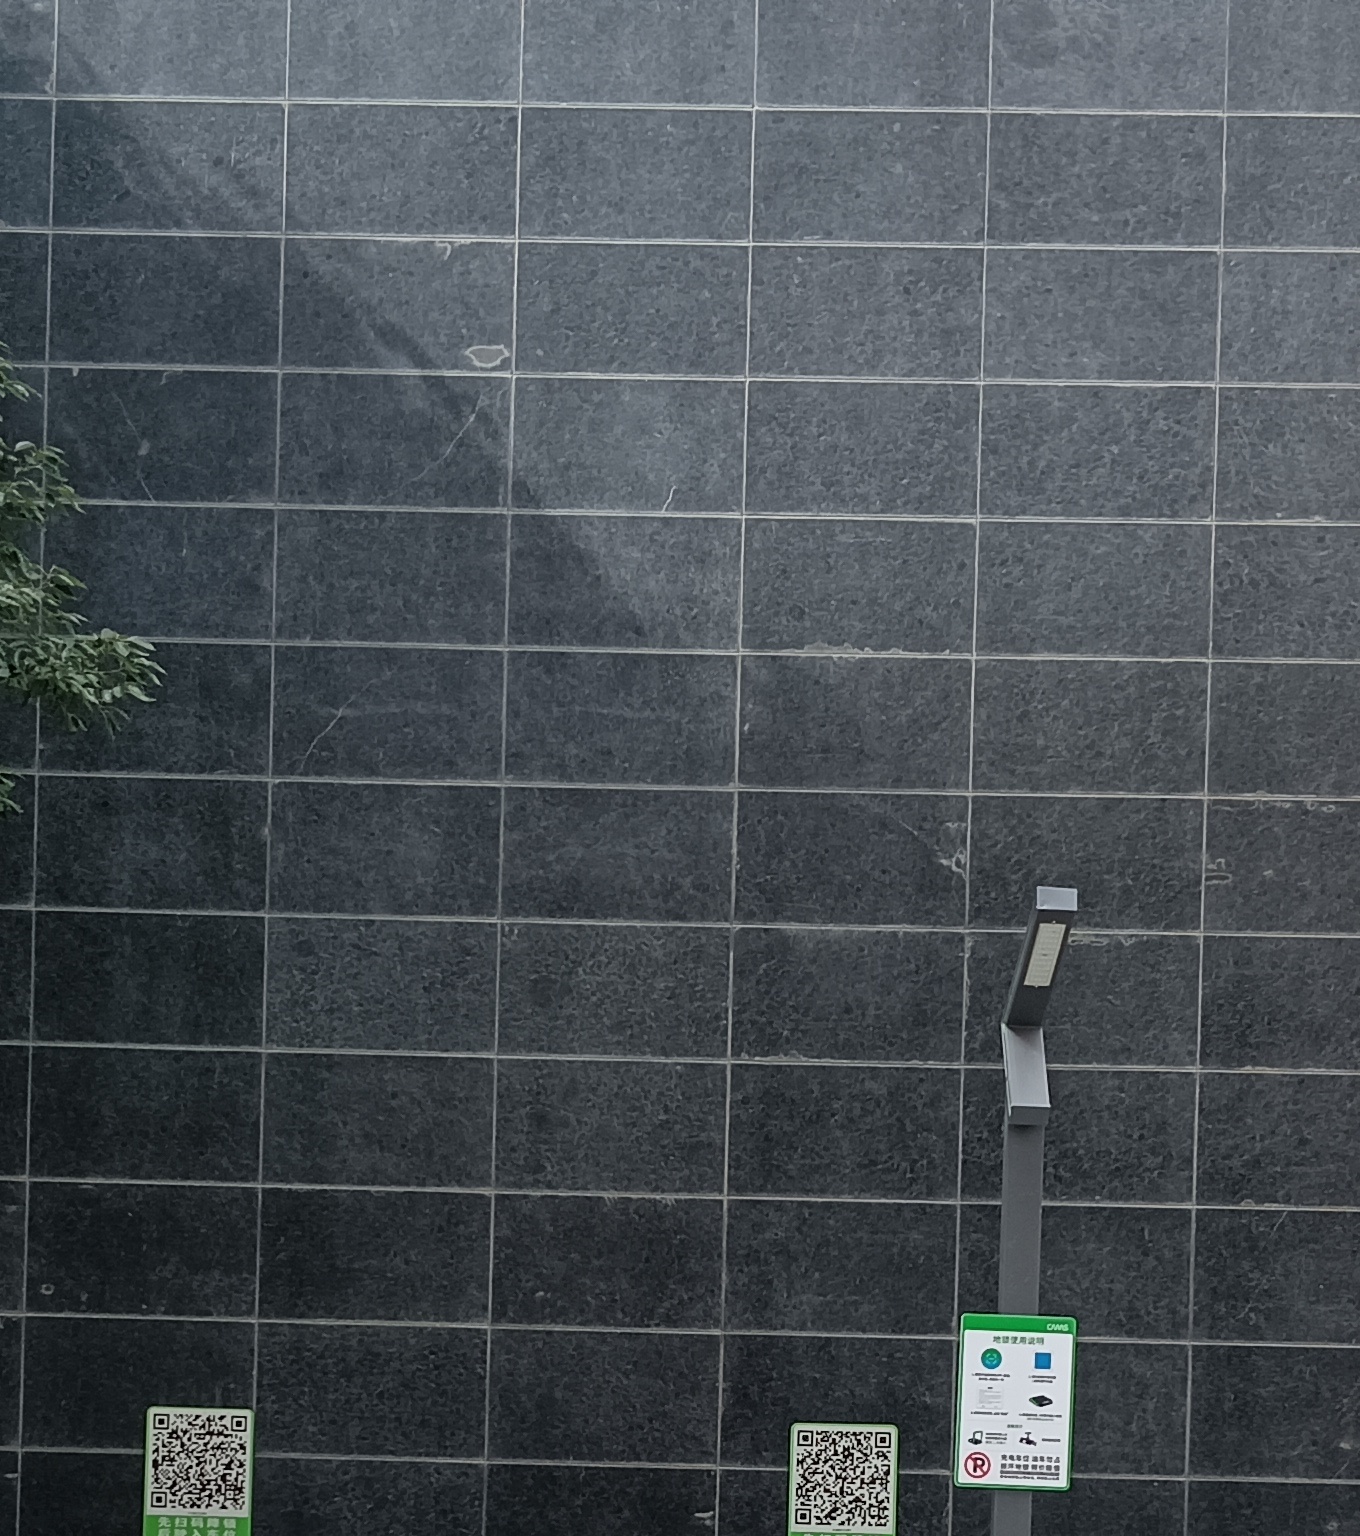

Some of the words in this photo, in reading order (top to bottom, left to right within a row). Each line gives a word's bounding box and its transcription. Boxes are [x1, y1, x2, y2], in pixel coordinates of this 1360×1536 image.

[158, 1517, 236, 1528] 先扫码降锁
